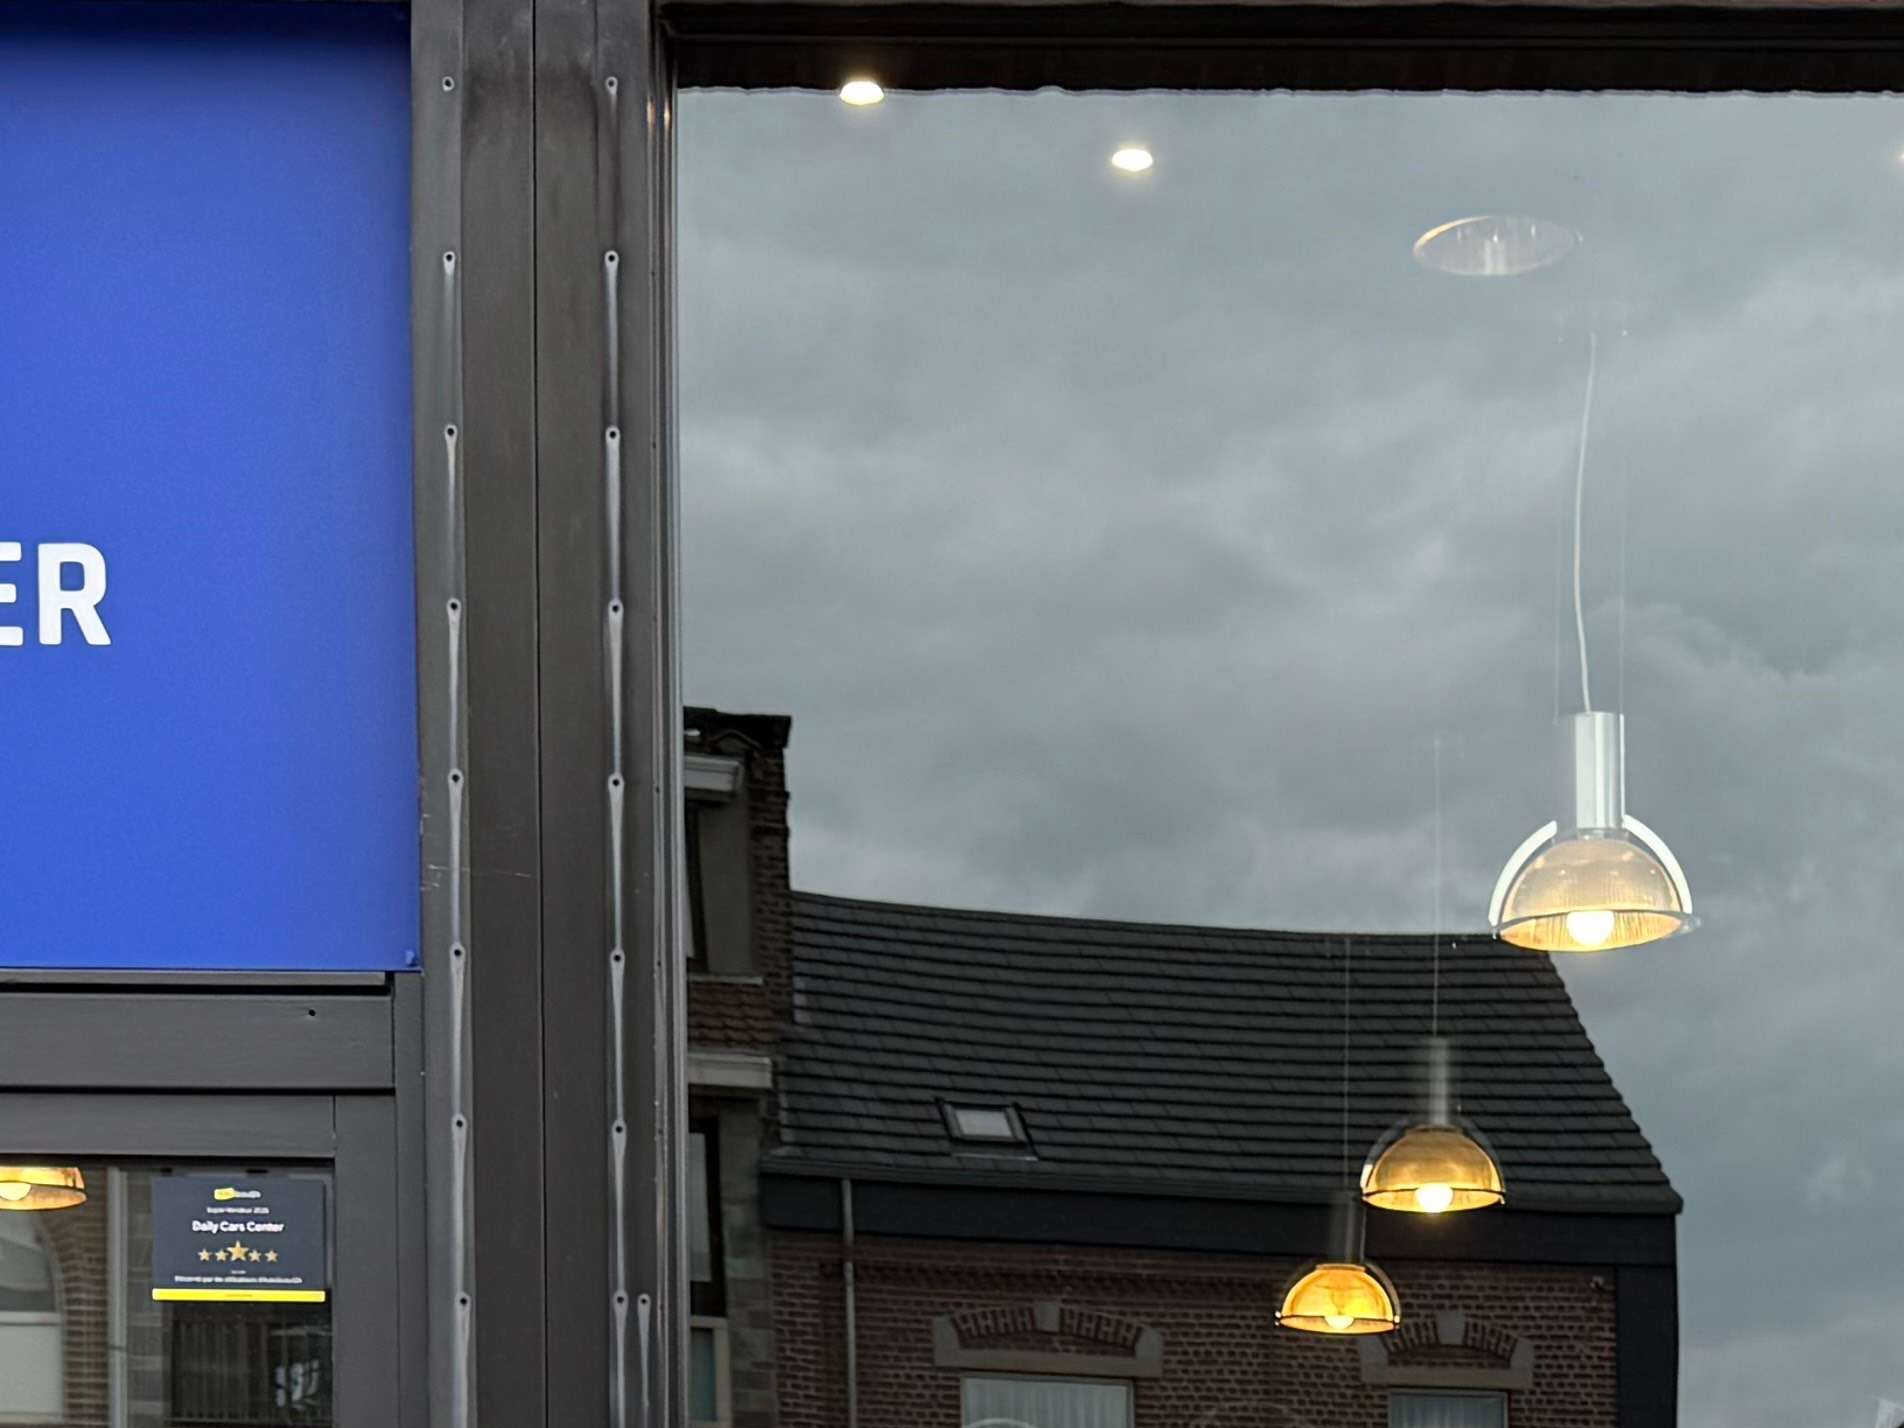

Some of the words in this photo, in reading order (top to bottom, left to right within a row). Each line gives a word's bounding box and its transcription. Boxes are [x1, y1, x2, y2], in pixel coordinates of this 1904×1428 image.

[192, 1220, 219, 1234] Daily
[220, 1220, 245, 1232] Cars
[246, 1220, 284, 1232] Center
